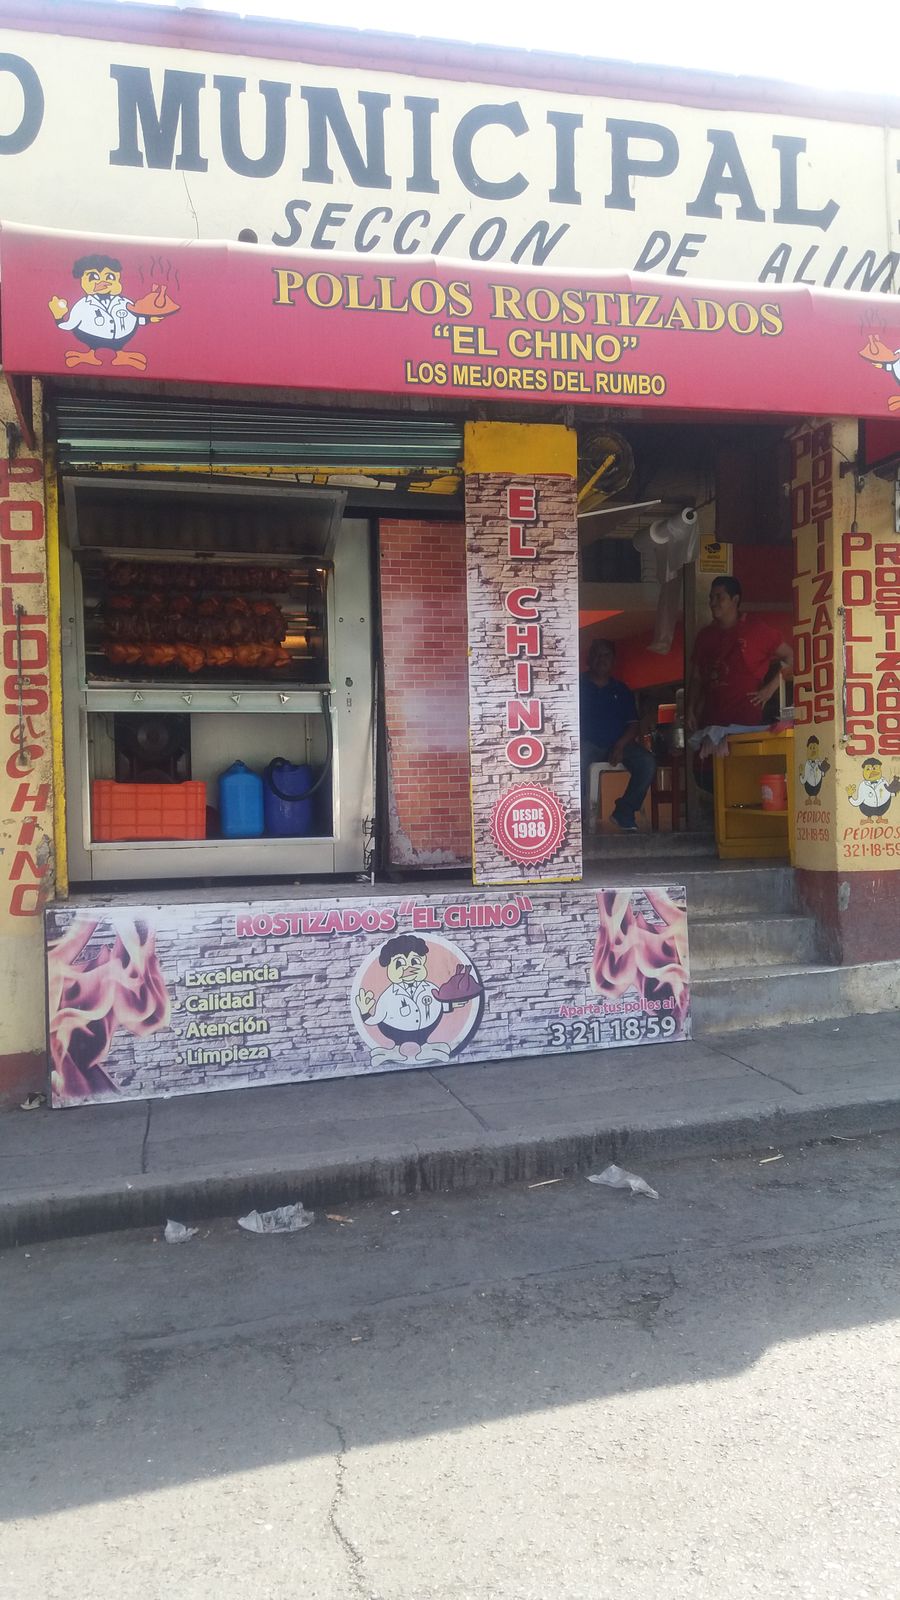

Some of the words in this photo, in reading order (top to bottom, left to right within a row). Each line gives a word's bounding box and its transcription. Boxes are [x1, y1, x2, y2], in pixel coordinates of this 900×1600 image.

[109, 64, 840, 232] MUNICIPAL
[271, 199, 571, 267] SECCION
[633, 230, 707, 277] DE
[272, 268, 474, 318] POLLOS
[490, 283, 784, 336] ROSTIZADOS
[406, 361, 448, 386] LOS
[452, 365, 548, 391] MEJORES
[552, 370, 592, 393] DEL
[595, 373, 666, 396] RUMBO
[507, 488, 537, 559] EL
[0, 458, 49, 715] POLLOS
[842, 533, 875, 756] POLLOS
[505, 586, 545, 768] CHINO
[511, 821, 546, 838] 1988
[512, 808, 544, 821] DESDE
[796, 811, 831, 824] PEDIDOS
[6, 744, 50, 917] CHINO
[843, 826, 900, 840] PEDIDOS
[235, 909, 397, 938] ROSTIZADOS
[185, 964, 279, 987] Excelencia
[185, 991, 255, 1013] Calidad
[559, 1004, 602, 1017] Aparta
[603, 1002, 621, 1014] tus
[624, 998, 661, 1013] pollos
[186, 1016, 268, 1039] Atención
[550, 1023, 566, 1047] 3
[571, 1020, 601, 1045] 21
[610, 1018, 640, 1041] 18
[645, 1015, 677, 1039] 59
[186, 1045, 270, 1066] Limpieza
